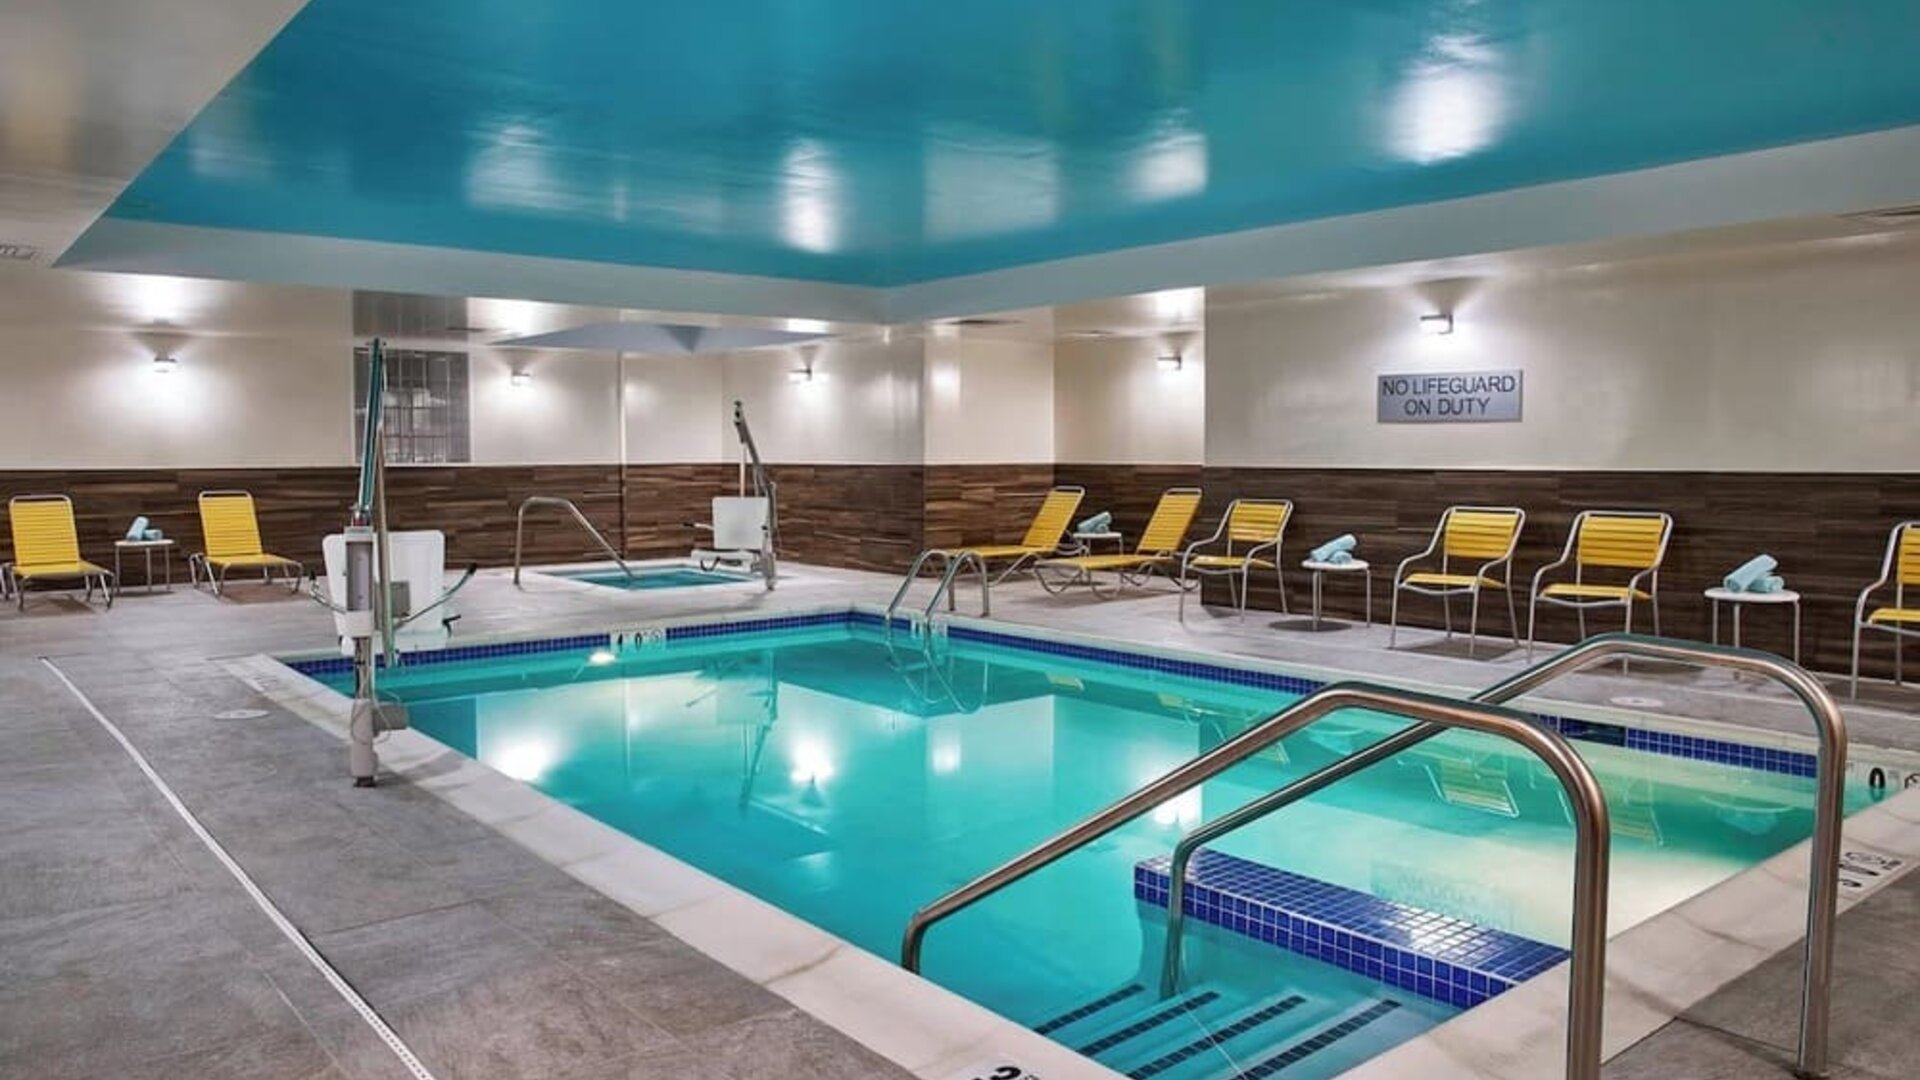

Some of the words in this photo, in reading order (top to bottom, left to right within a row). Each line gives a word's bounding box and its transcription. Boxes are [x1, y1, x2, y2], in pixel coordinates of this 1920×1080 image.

[1383, 379, 1408, 395] NO
[1413, 376, 1515, 395] LIFEGUARD
[1404, 398, 1431, 415] ON
[1438, 397, 1490, 415] DUTY
